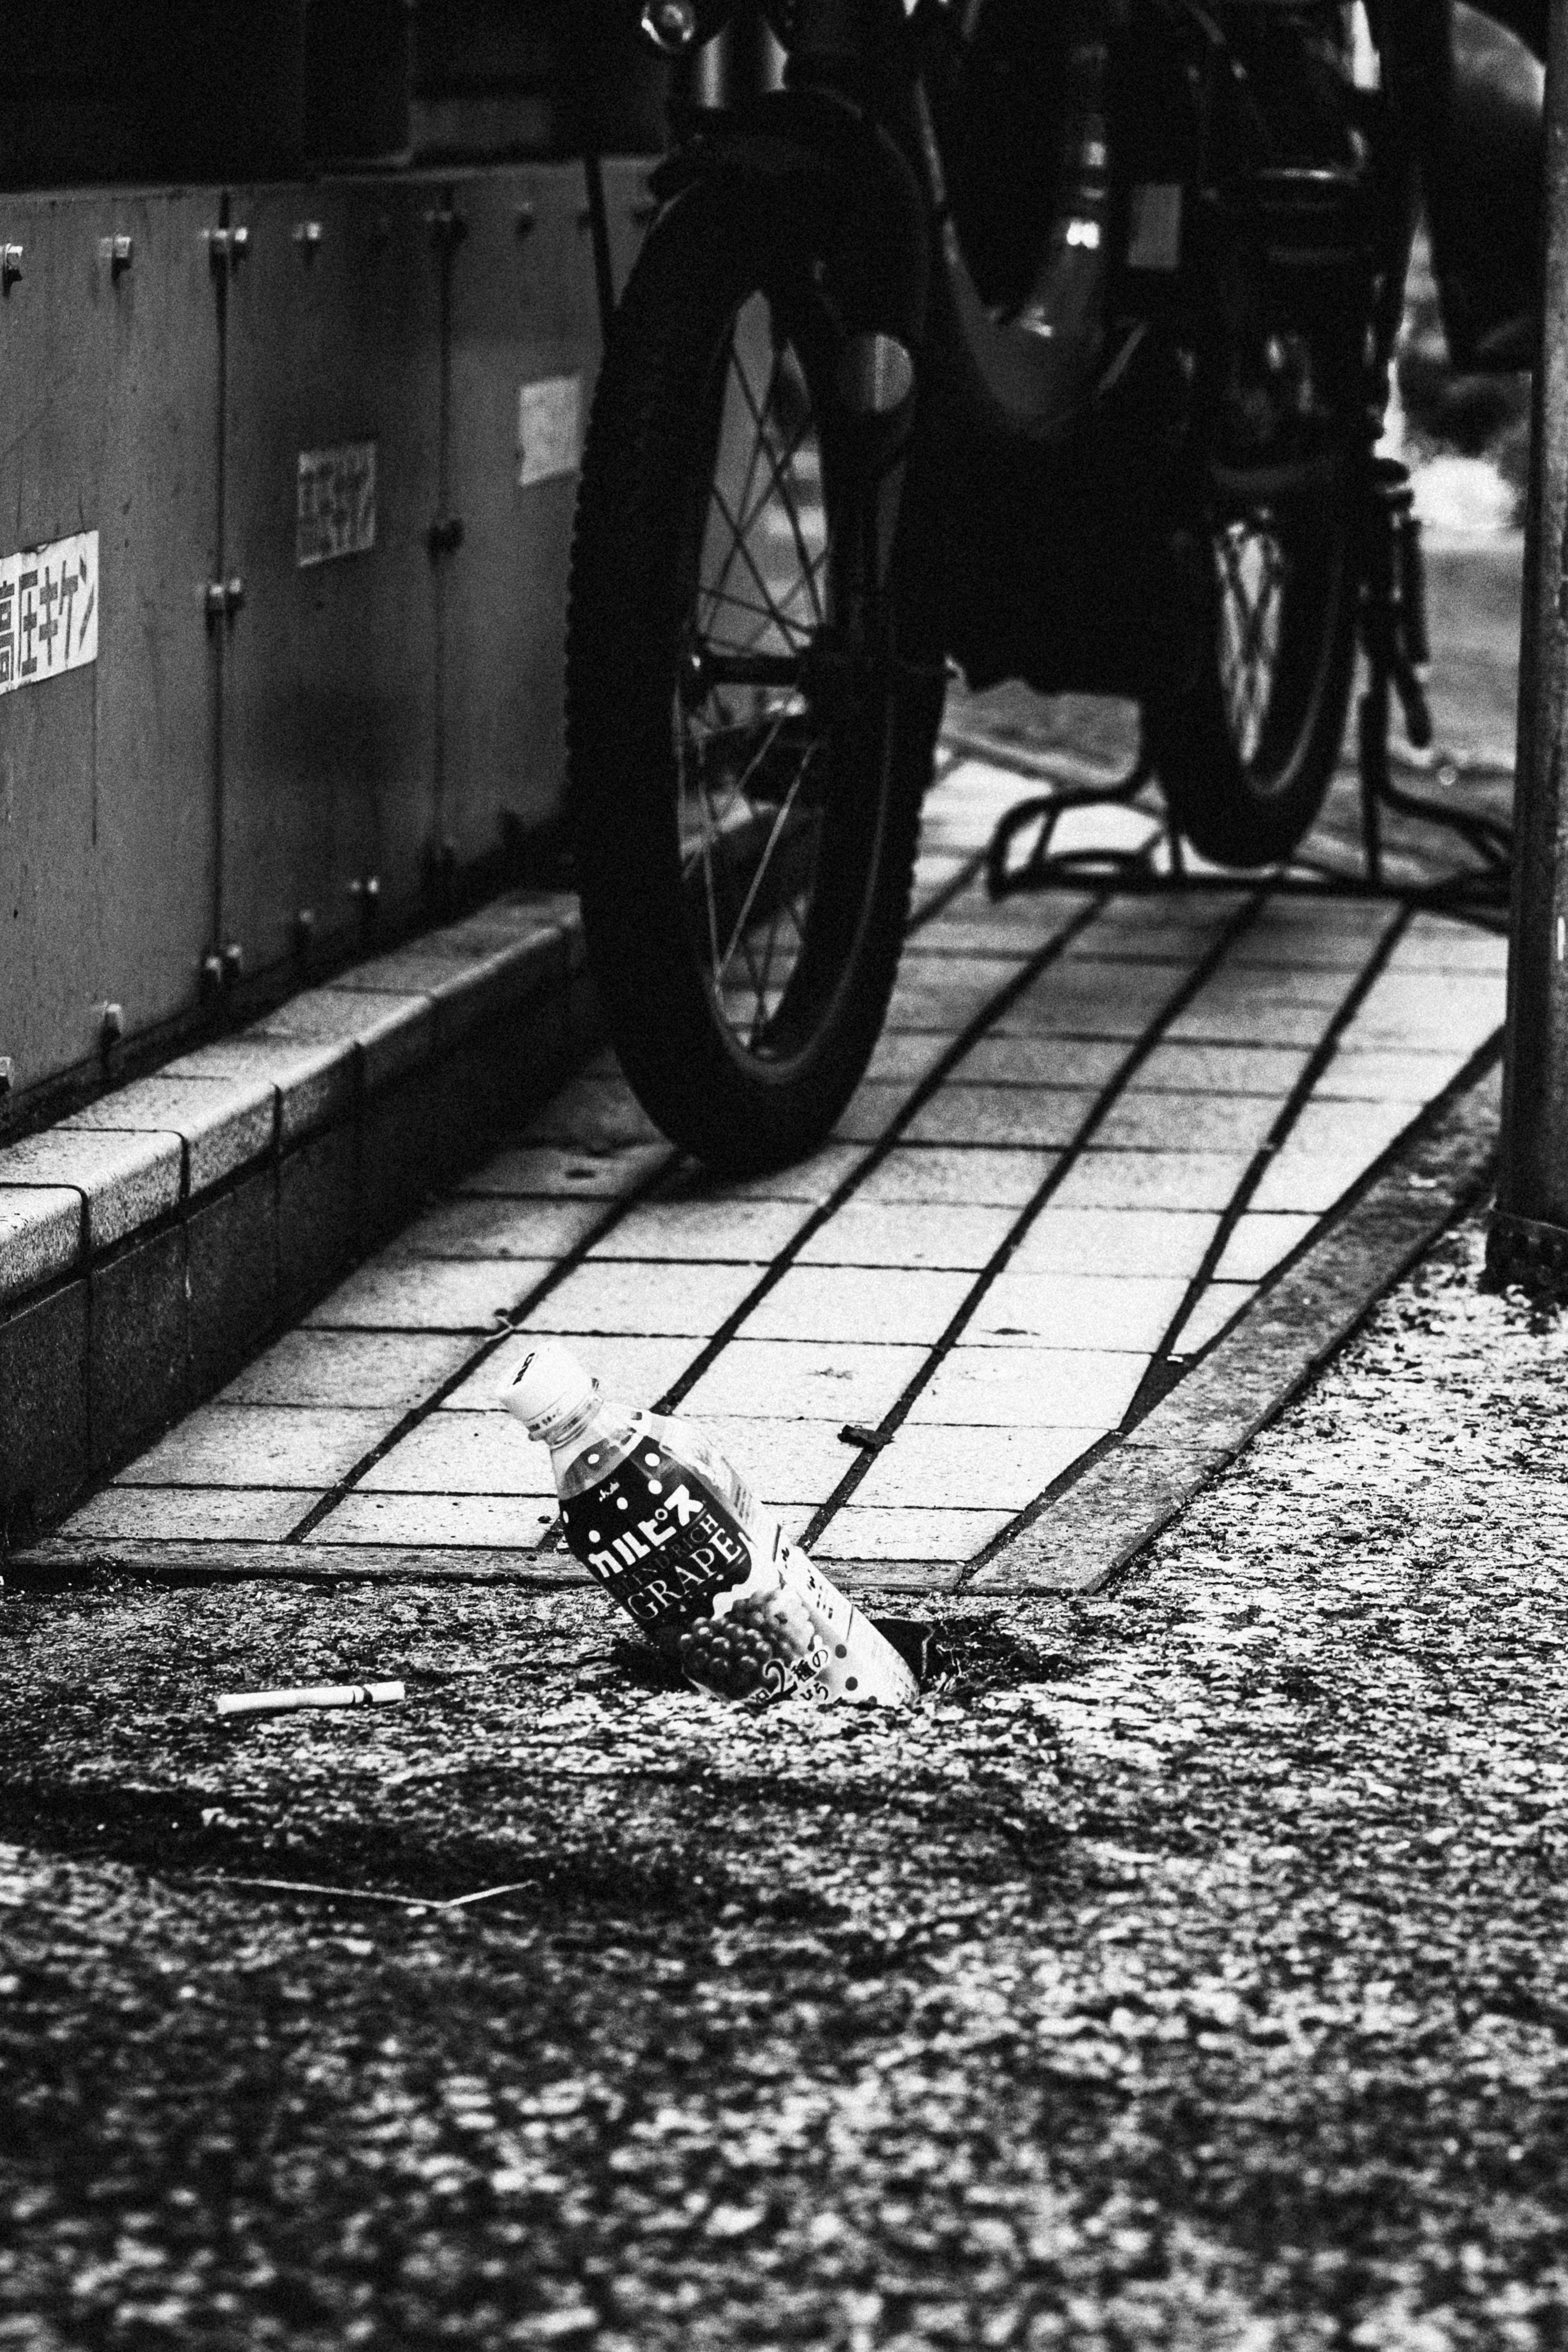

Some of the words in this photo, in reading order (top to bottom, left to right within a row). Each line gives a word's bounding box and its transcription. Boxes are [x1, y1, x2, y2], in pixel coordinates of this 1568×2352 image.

[588, 1484, 704, 1578] カルピス
[627, 1528, 742, 1619] GRAPE
[670, 1514, 719, 1566] RICH
